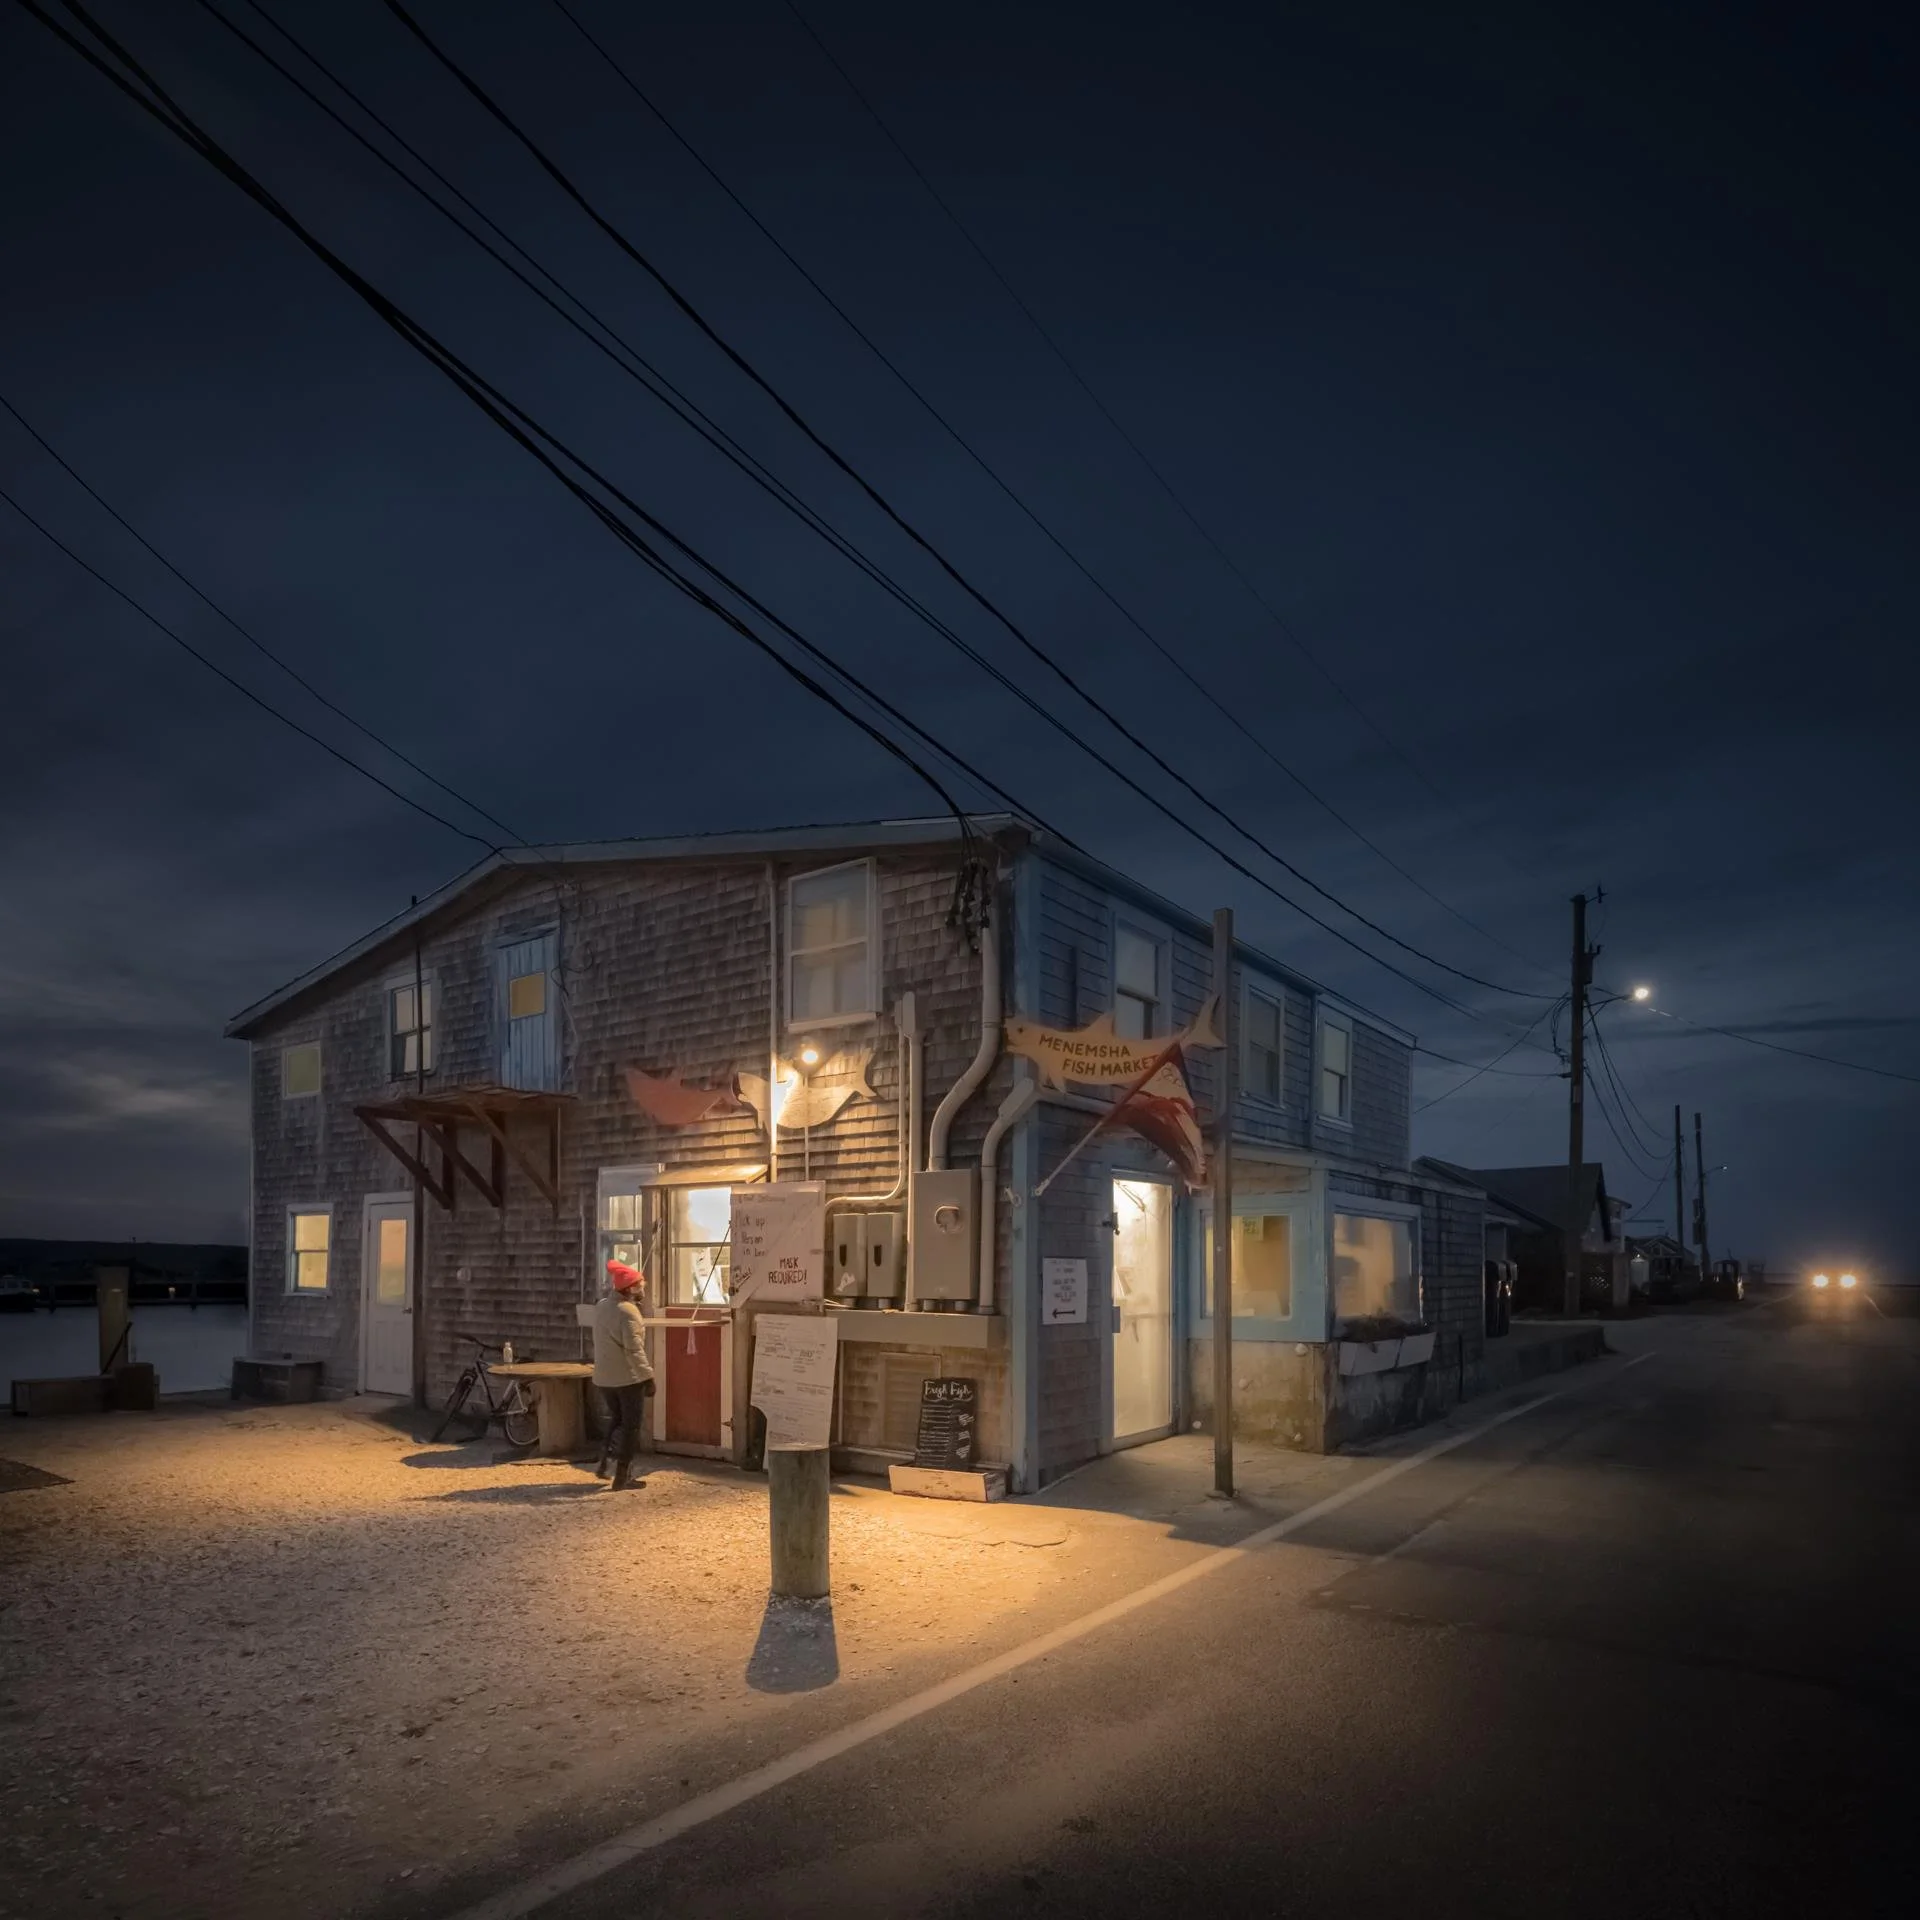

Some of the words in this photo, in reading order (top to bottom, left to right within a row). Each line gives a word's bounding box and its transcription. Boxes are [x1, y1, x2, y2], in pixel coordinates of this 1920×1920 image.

[1039, 1034, 1131, 1058] MENEMSHA
[1062, 1058, 1096, 1077] FISH
[779, 1256, 799, 1270] MASK
[924, 1381, 948, 1398] Fresh
[949, 1381, 972, 1398] Fish
